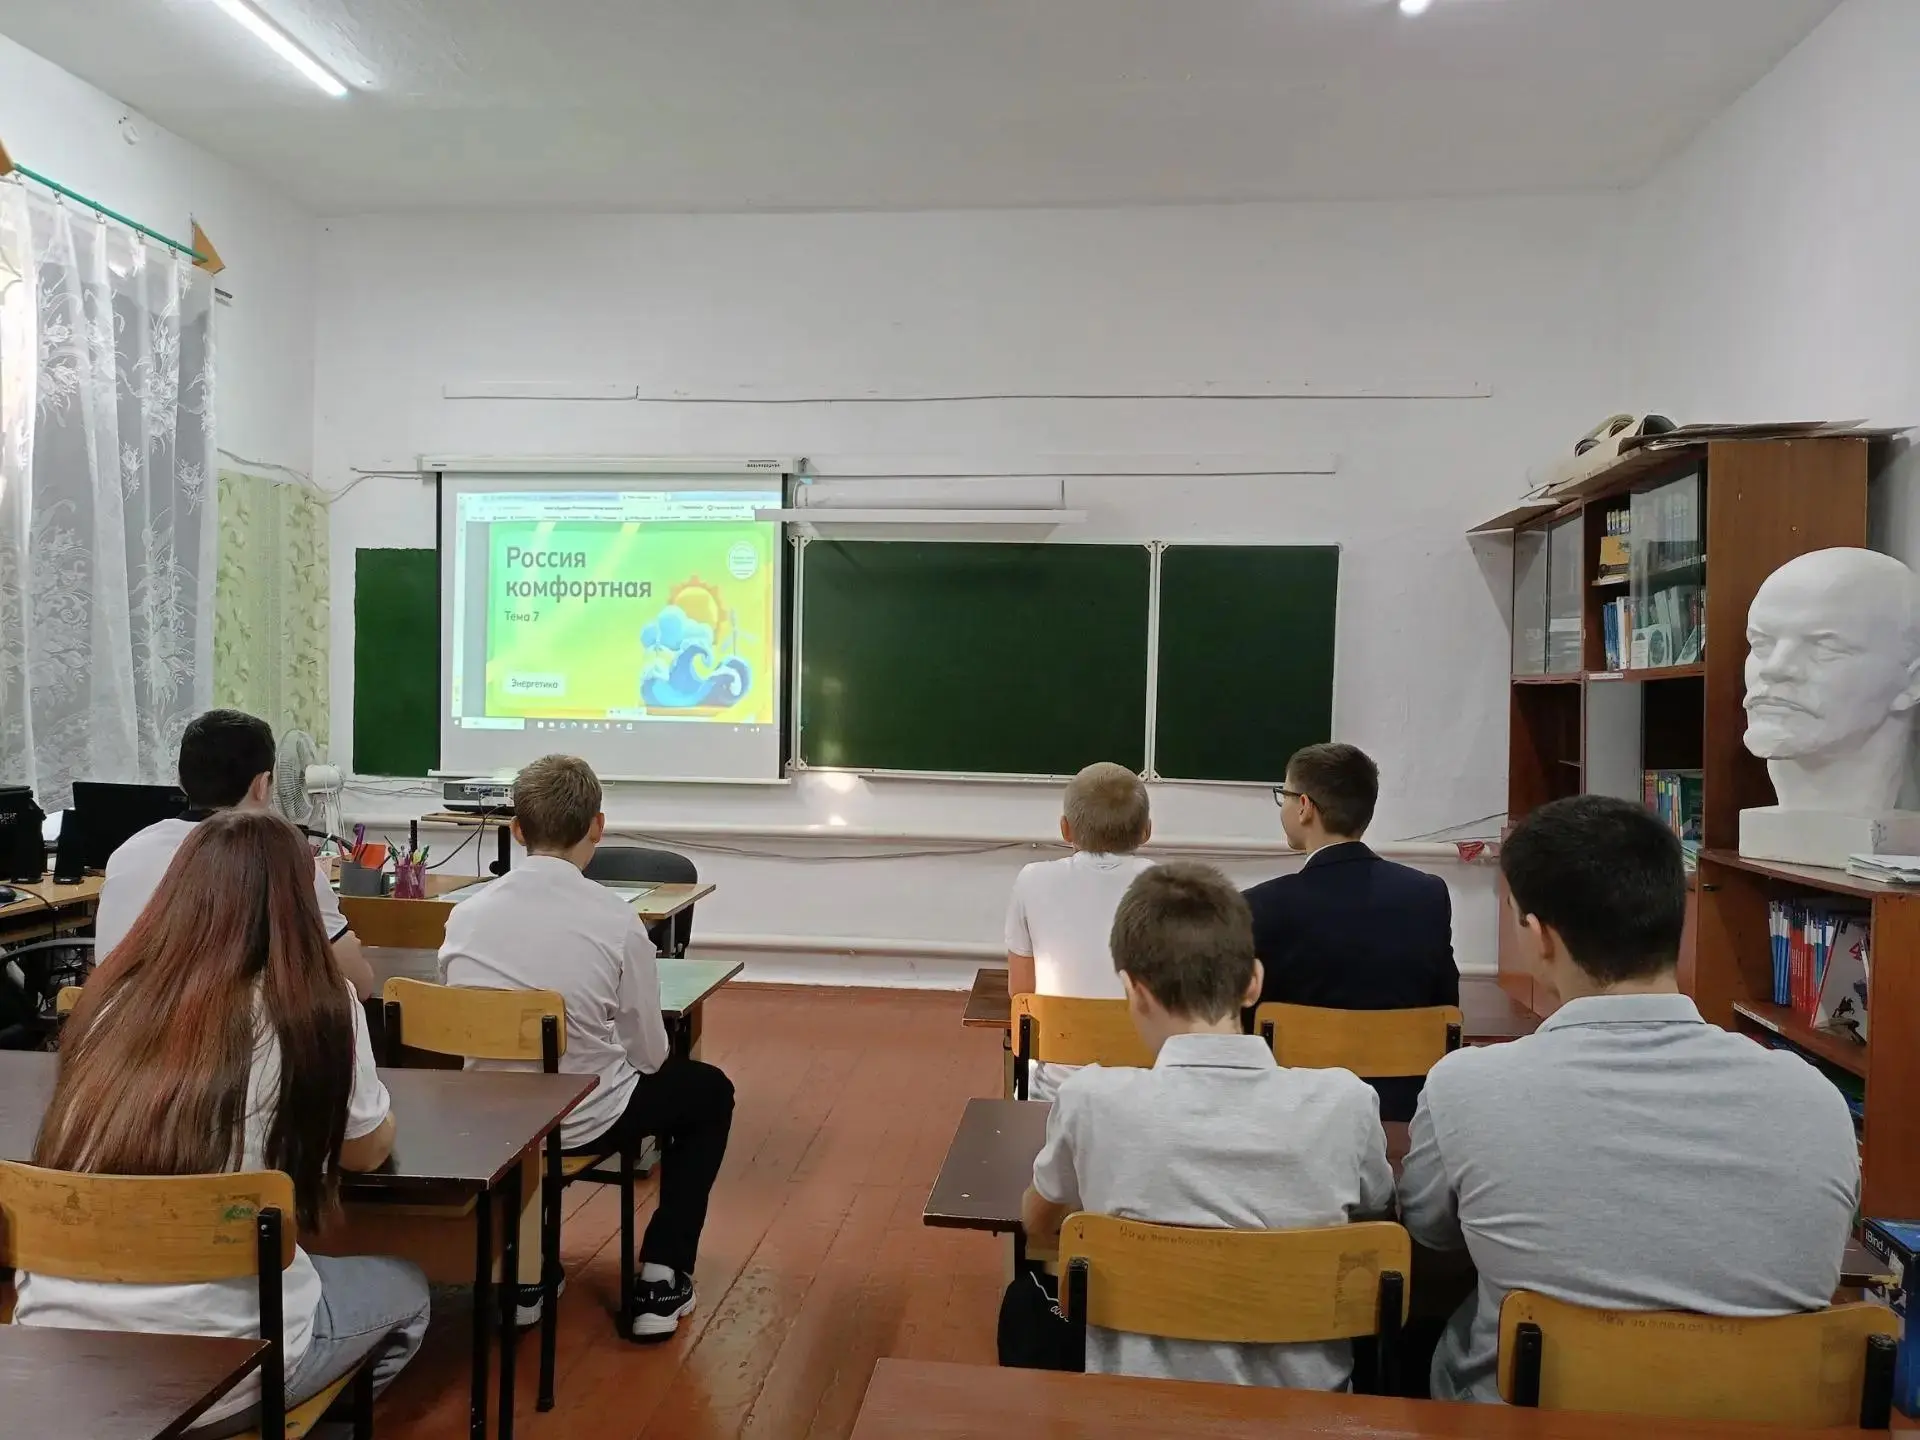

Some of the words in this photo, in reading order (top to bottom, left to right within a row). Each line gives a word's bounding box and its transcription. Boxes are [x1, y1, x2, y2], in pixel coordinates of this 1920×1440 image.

[506, 546, 587, 569] Россия
[505, 574, 653, 604] комфортная
[504, 610, 531, 622] Тема
[533, 611, 541, 622] 7
[511, 678, 559, 690] Энергетика
